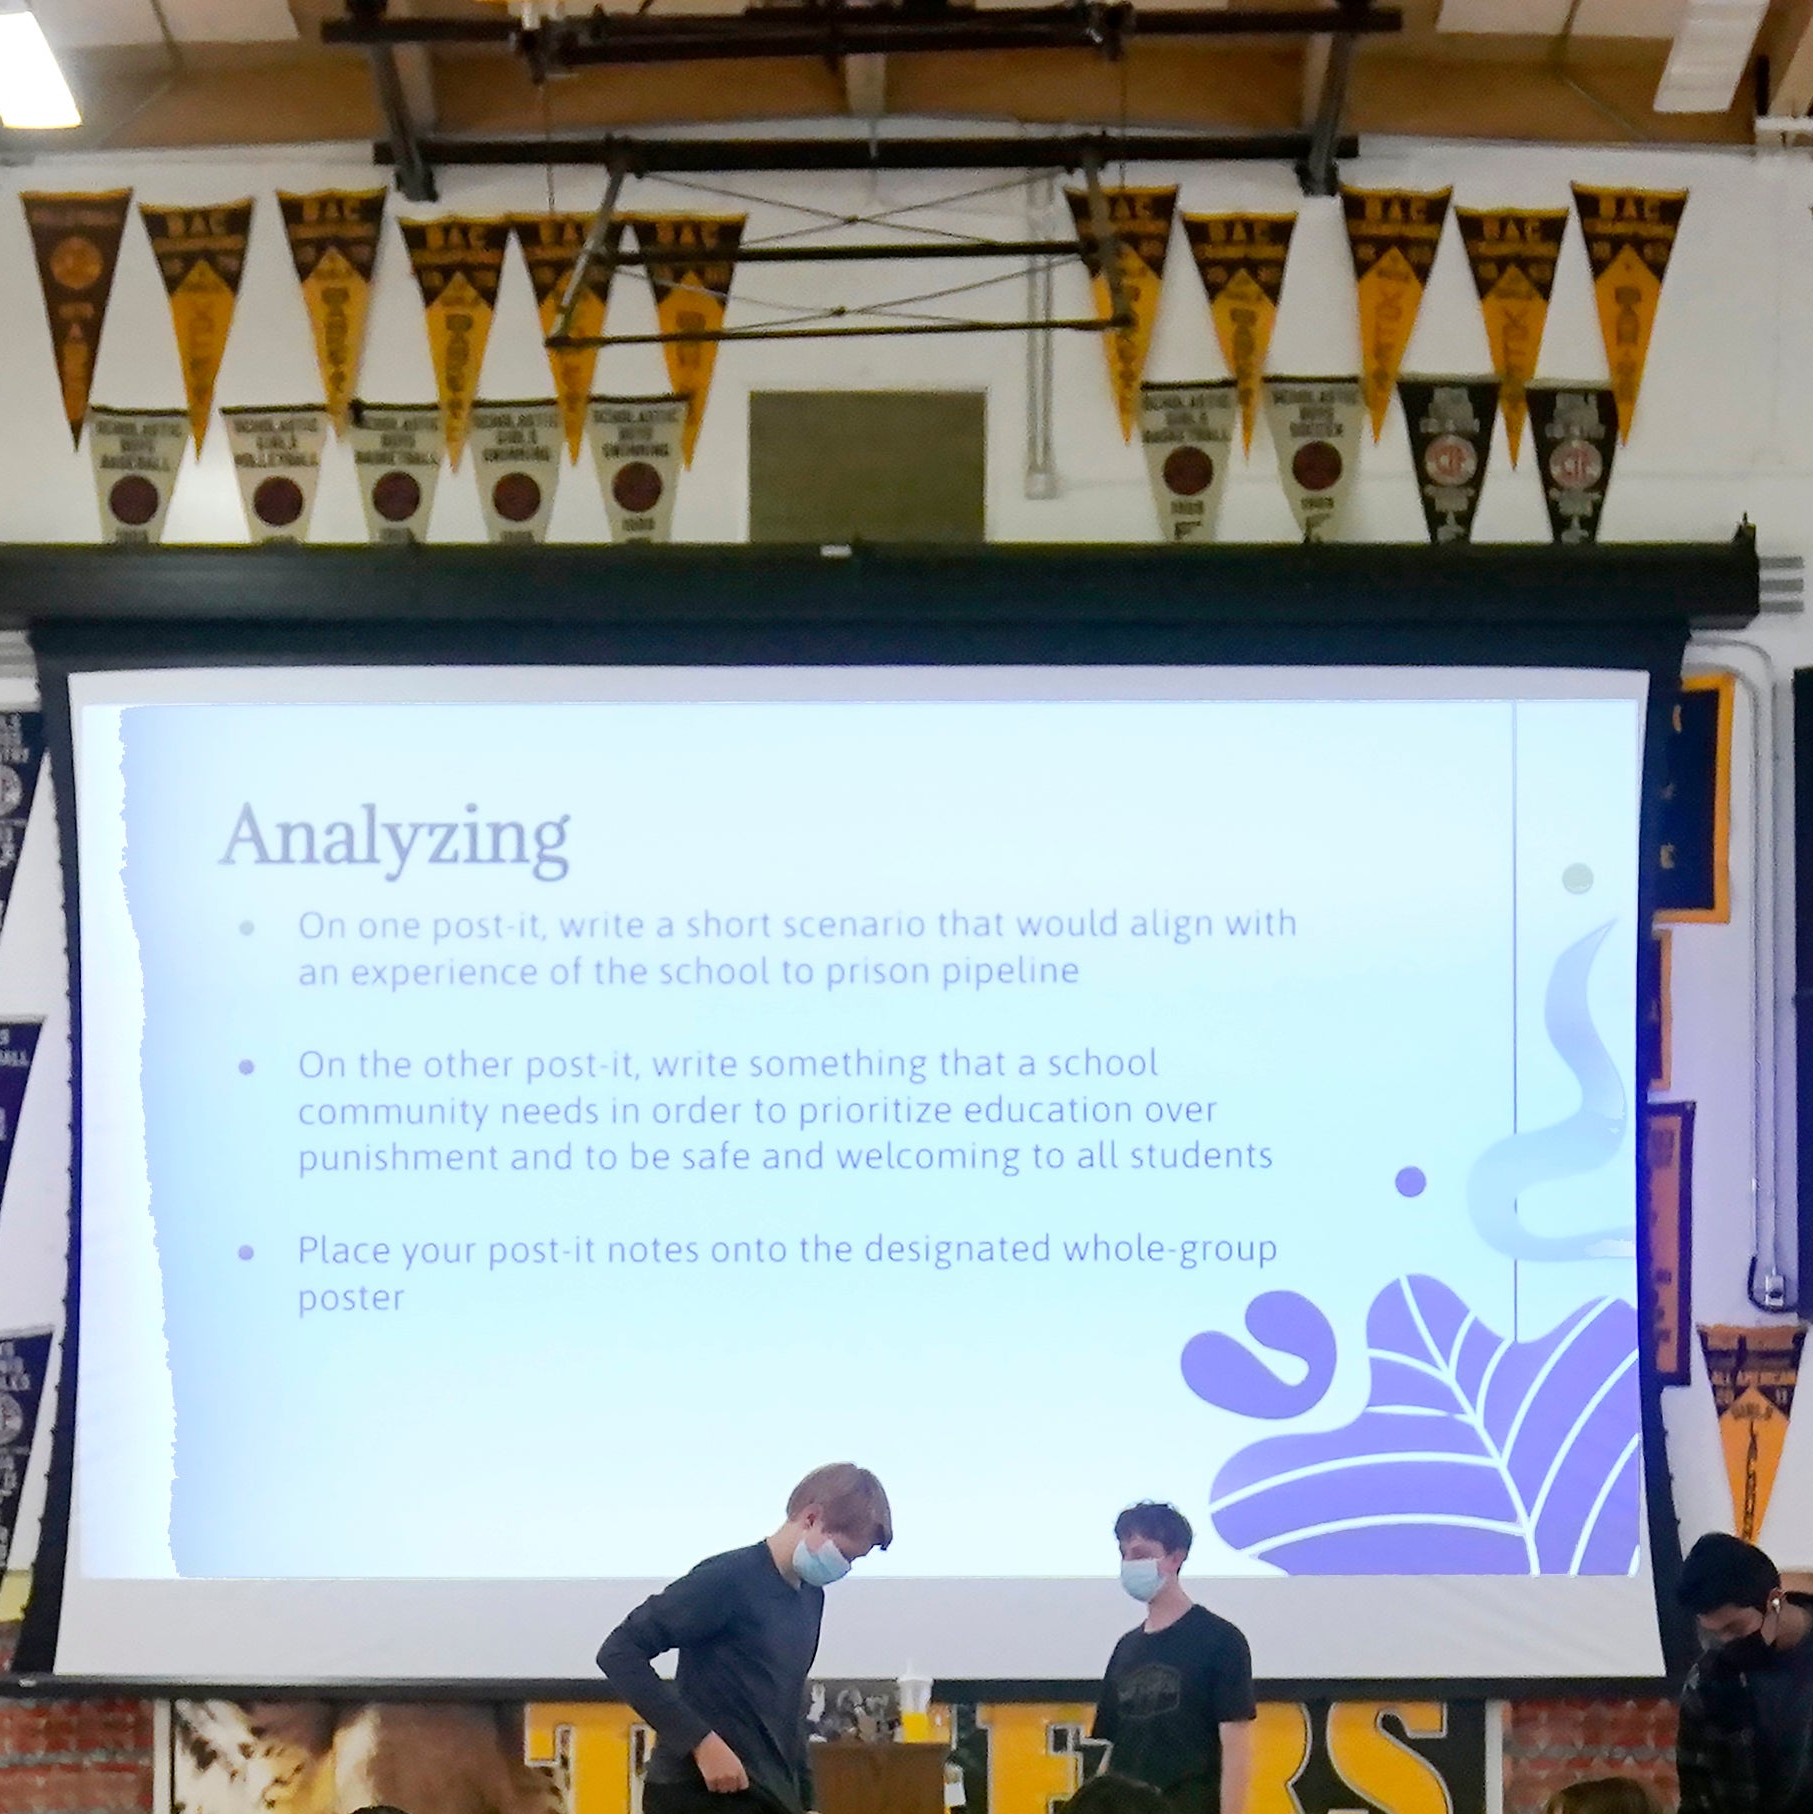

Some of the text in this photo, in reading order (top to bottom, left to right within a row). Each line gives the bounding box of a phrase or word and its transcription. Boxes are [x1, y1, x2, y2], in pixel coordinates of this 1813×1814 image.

[216, 799, 573, 885] Analyzing
[297, 906, 1298, 947] On one post-it, write a short scenario that would align with
[297, 953, 1081, 994] an experience of the school to prison pipeline
[297, 1045, 1160, 1087] On the other post-it, write something that a school
[297, 1092, 1219, 1134] community needs in order to prioritize education over
[298, 1137, 1275, 1181] punishment and to be safe and welcoming to all students
[298, 1230, 1279, 1274] Place your post-it notes onto the designated whole-group
[297, 1284, 407, 1321] poster
